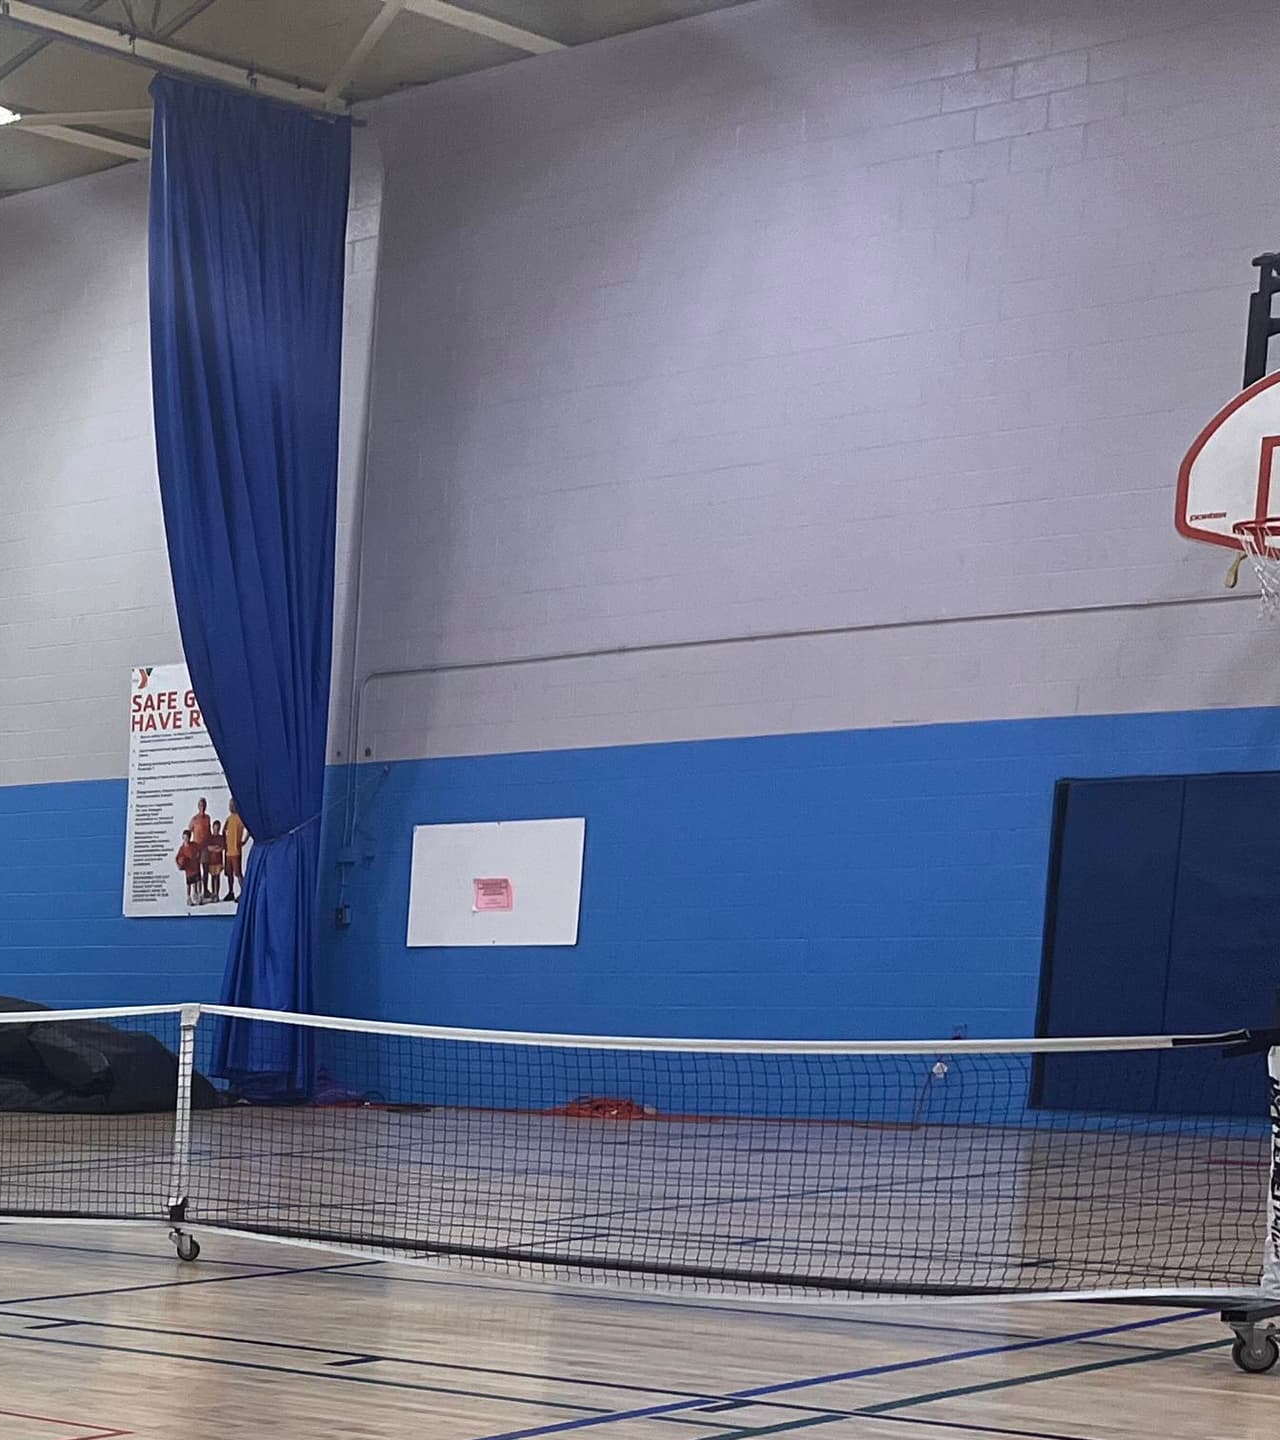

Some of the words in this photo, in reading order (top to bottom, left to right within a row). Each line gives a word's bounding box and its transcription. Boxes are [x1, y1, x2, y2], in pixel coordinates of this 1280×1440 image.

[132, 691, 177, 712] SAFE
[184, 690, 196, 708] G
[131, 711, 182, 732] HAVE
[189, 709, 201, 728] R
